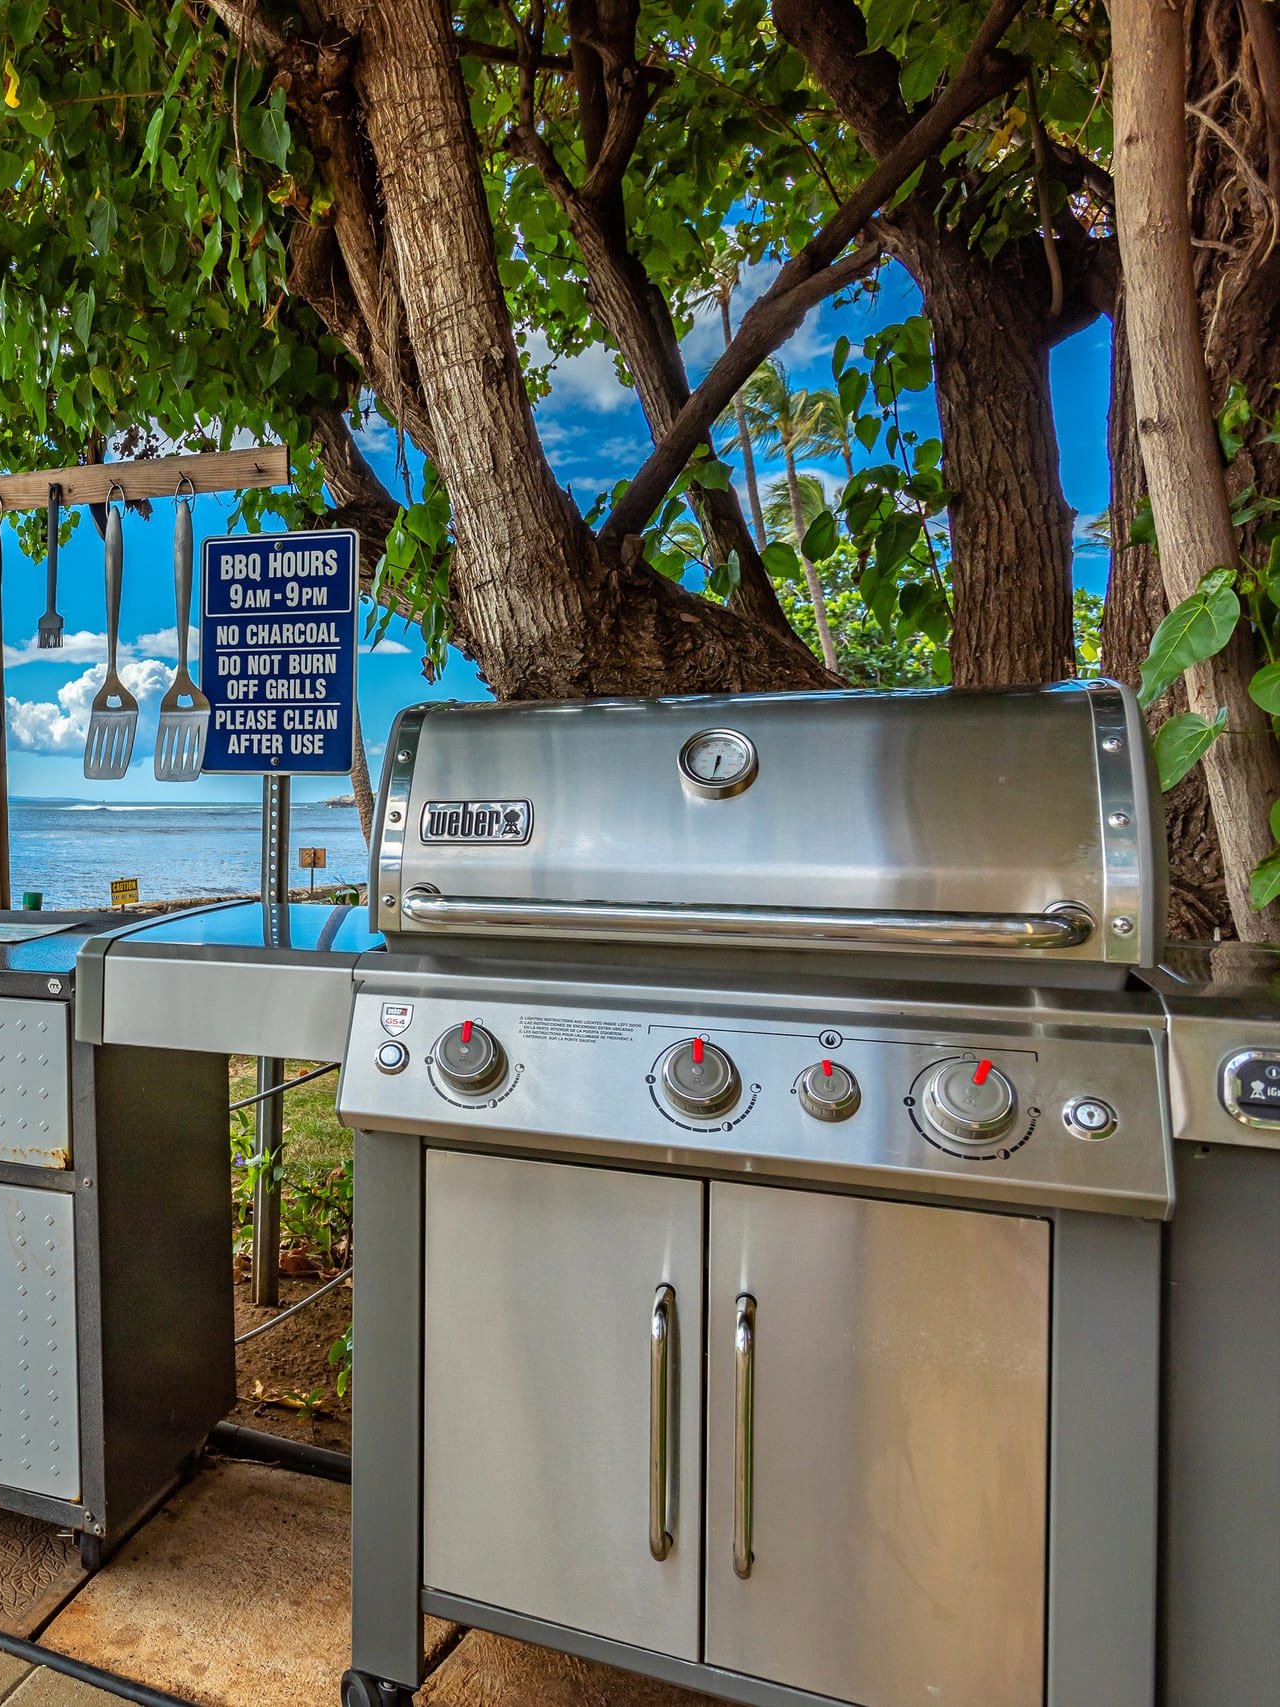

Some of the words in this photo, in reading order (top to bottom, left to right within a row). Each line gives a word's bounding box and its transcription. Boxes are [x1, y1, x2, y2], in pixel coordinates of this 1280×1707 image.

[220, 553, 261, 582] BBQ
[268, 549, 338, 578] HOURS
[216, 625, 239, 646] NO
[246, 622, 340, 645] CHARCOAL
[218, 655, 241, 676] DO
[247, 654, 282, 675] NOT
[288, 653, 336, 674] BURN
[226, 679, 259, 700] OFF
[265, 678, 327, 700] GRILLS
[215, 709, 277, 730] PLEASE
[283, 709, 338, 730] CLEAN
[227, 734, 283, 754] AFTER
[289, 734, 324, 754] USE
[429, 803, 501, 837] weber
[112, 880, 137, 892] CAUTION
